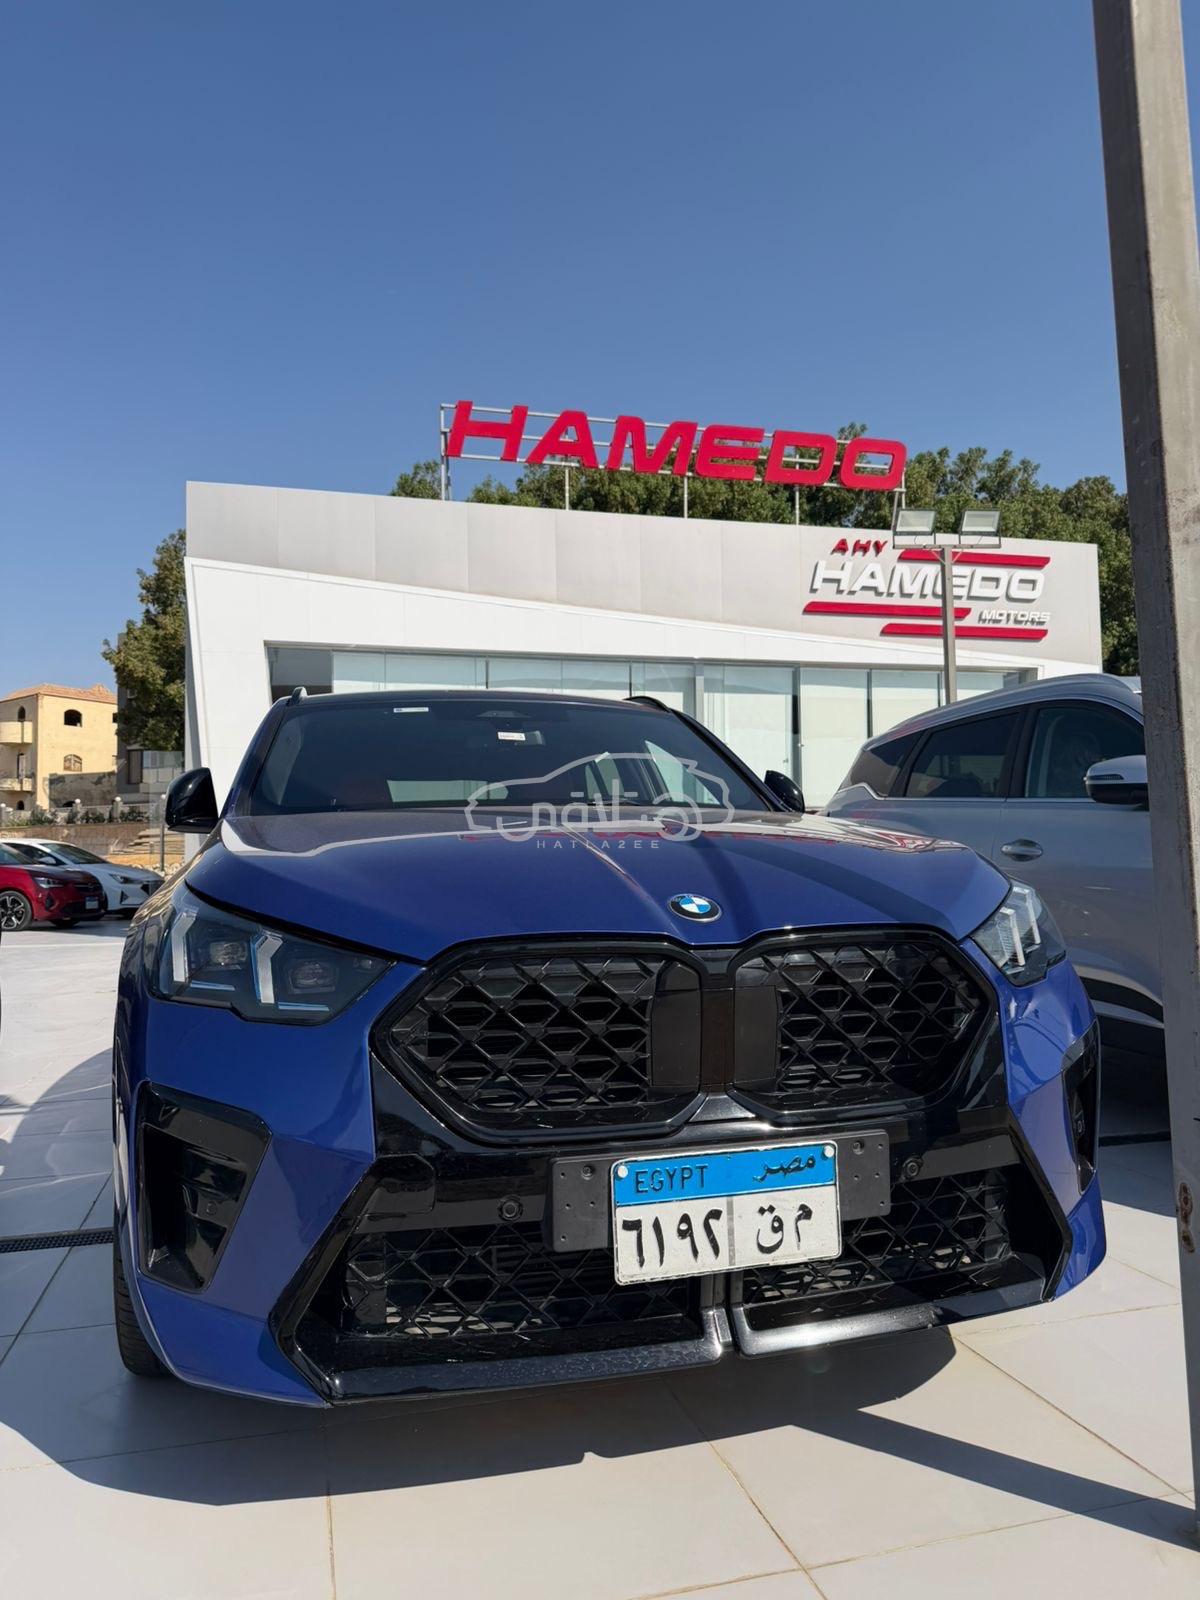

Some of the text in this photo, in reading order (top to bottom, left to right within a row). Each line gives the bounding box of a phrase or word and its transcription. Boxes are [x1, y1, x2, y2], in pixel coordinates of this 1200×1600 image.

[446, 400, 908, 491] HAMEDO
[831, 538, 888, 557] AHY
[979, 609, 1051, 626] MOTORS
[635, 1164, 709, 1195] EGYPT
[753, 1154, 816, 1183] مصر
